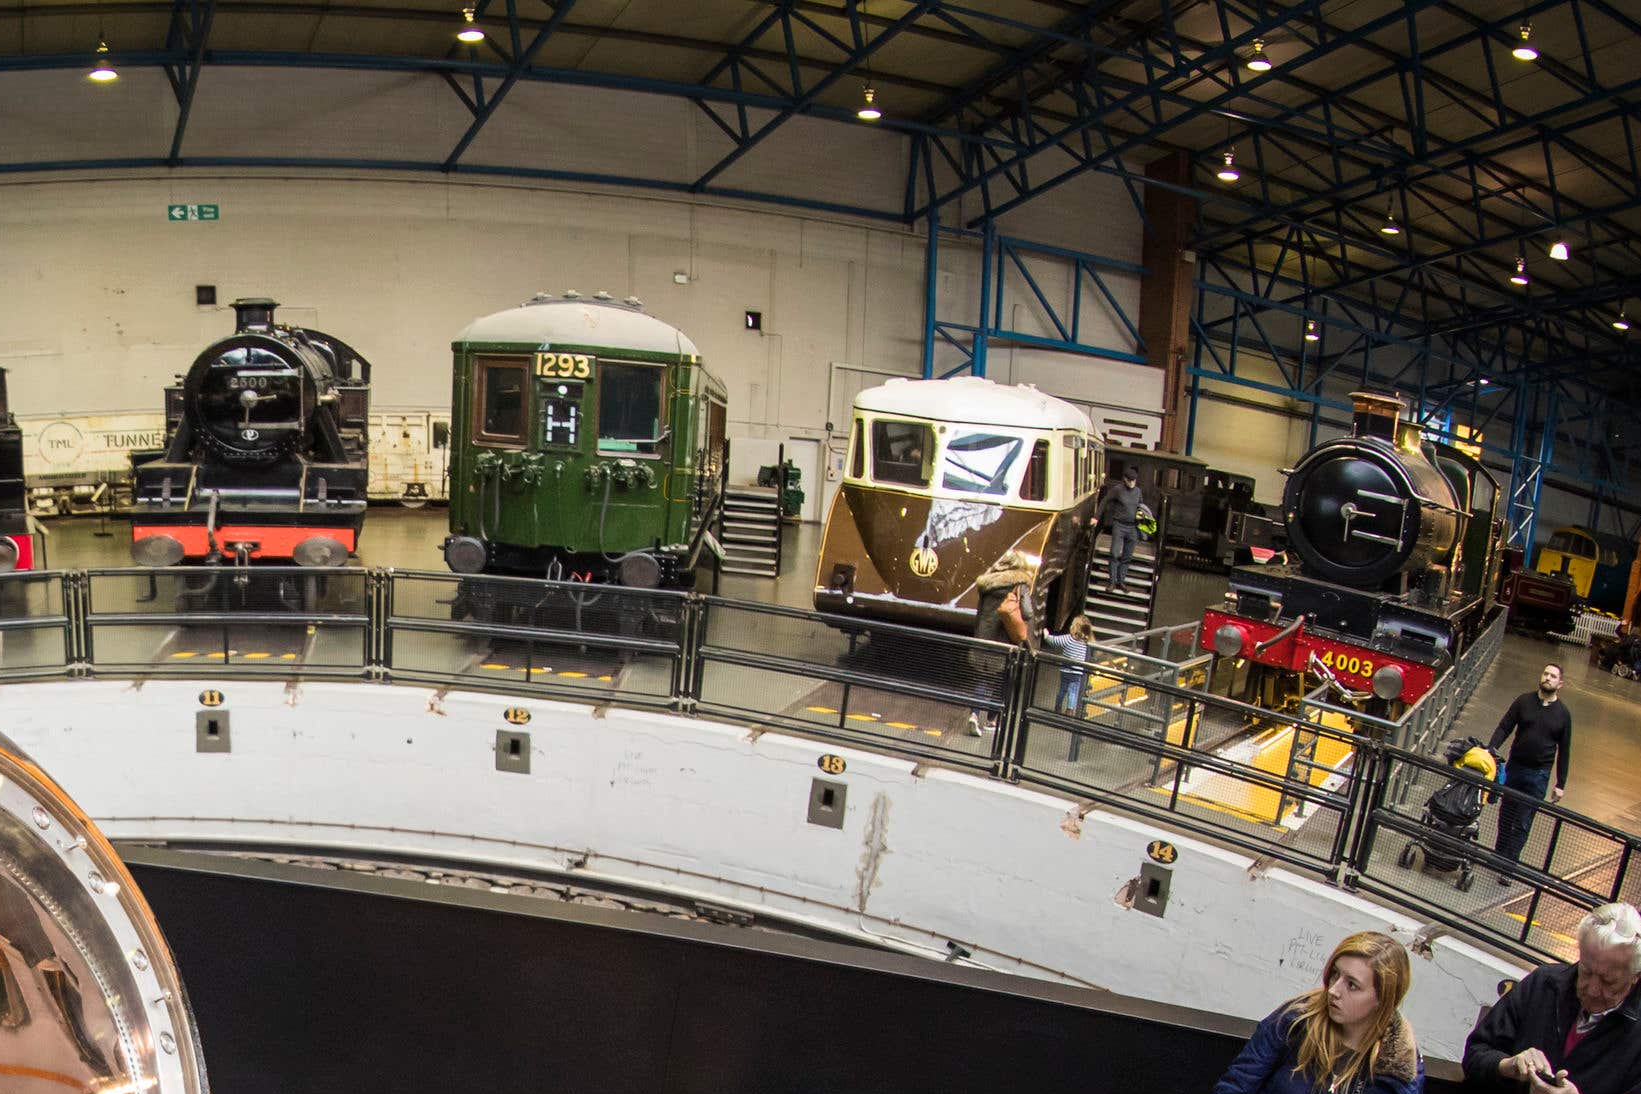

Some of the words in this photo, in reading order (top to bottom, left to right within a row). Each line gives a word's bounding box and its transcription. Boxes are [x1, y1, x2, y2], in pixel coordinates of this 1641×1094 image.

[536, 352, 590, 378] 1293
[230, 377, 267, 389] 2500
[103, 429, 166, 448] TUNNE
[1321, 650, 1373, 678] 4003
[203, 690, 221, 705] 11
[507, 708, 529, 723] 12
[821, 754, 845, 774] 13
[1150, 841, 1173, 862] 14
